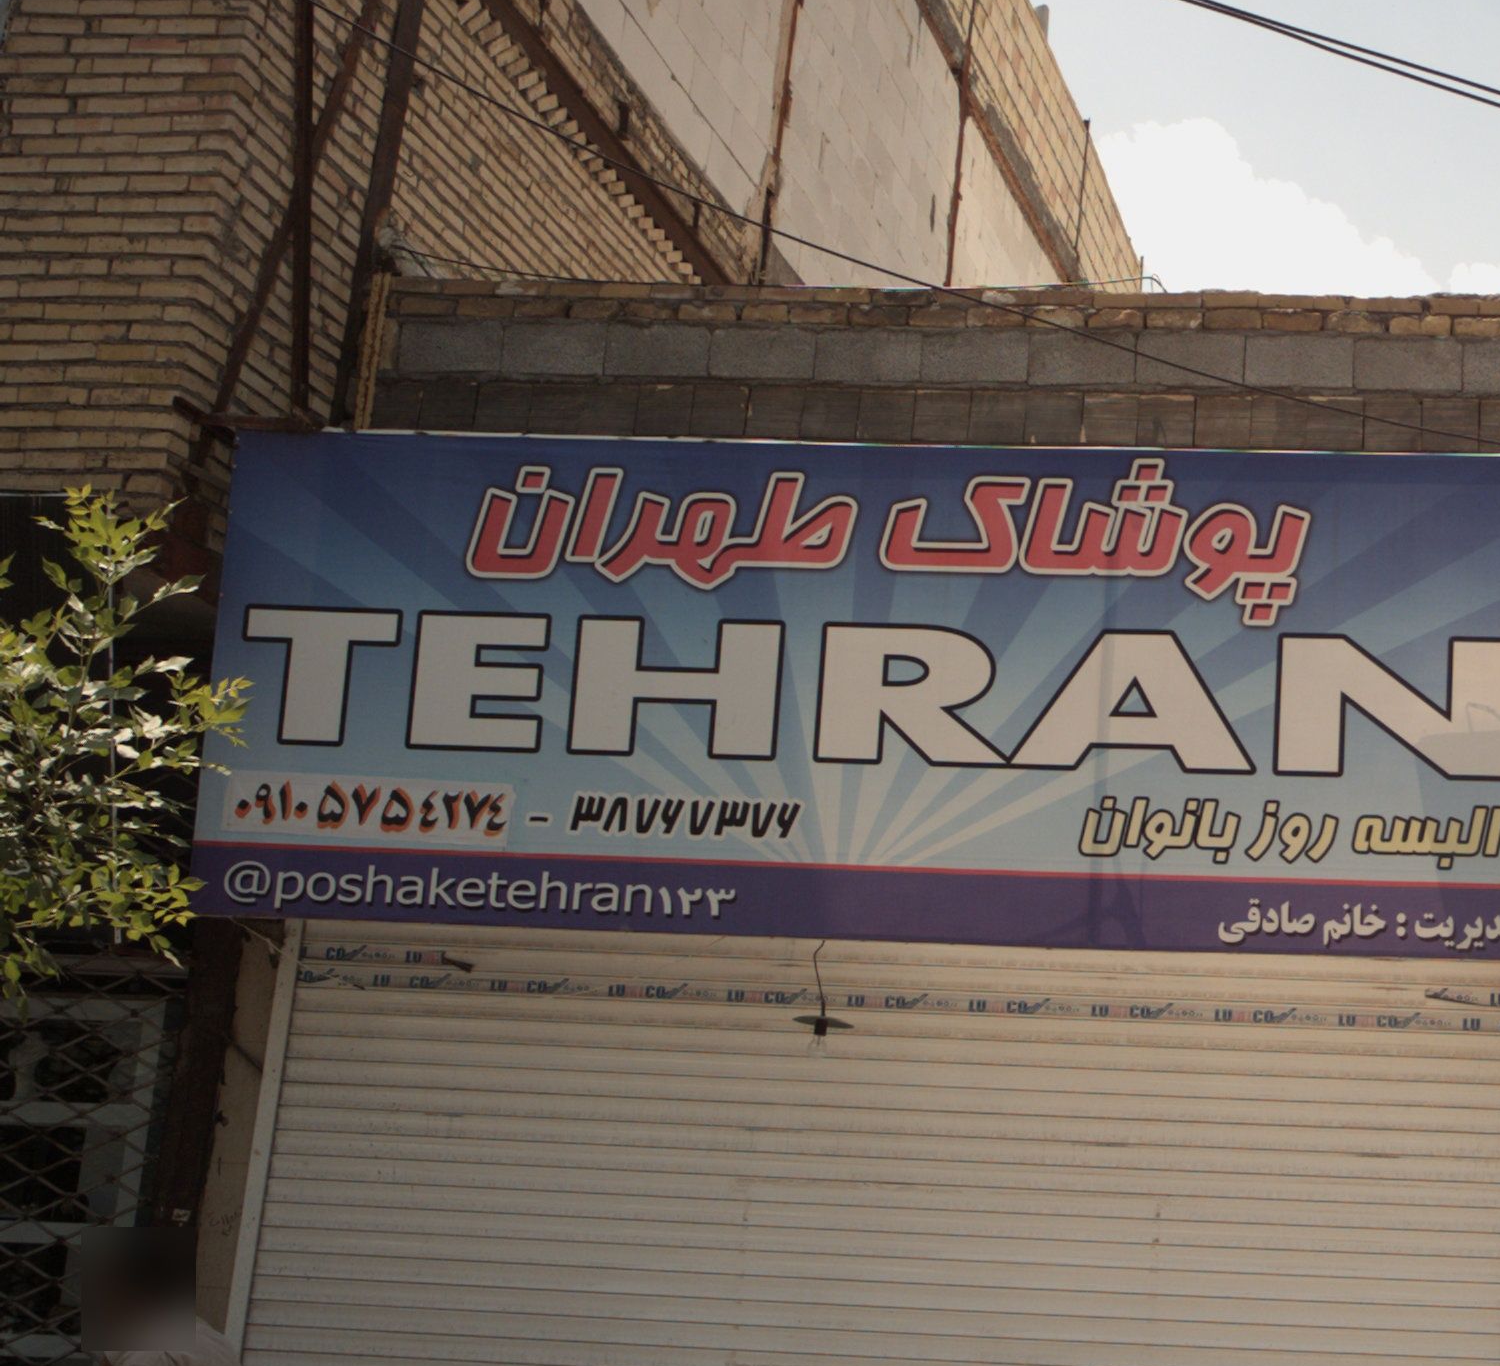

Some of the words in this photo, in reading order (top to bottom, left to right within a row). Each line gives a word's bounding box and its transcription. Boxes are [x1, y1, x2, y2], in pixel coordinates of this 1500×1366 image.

[466, 465, 859, 591] طهران
[879, 458, 1311, 627] پوشاک
[1080, 796, 1239, 863] بانوان
[1246, 800, 1339, 863] روز
[1217, 899, 1316, 943] صادقی
[1323, 904, 1386, 945] خانم
